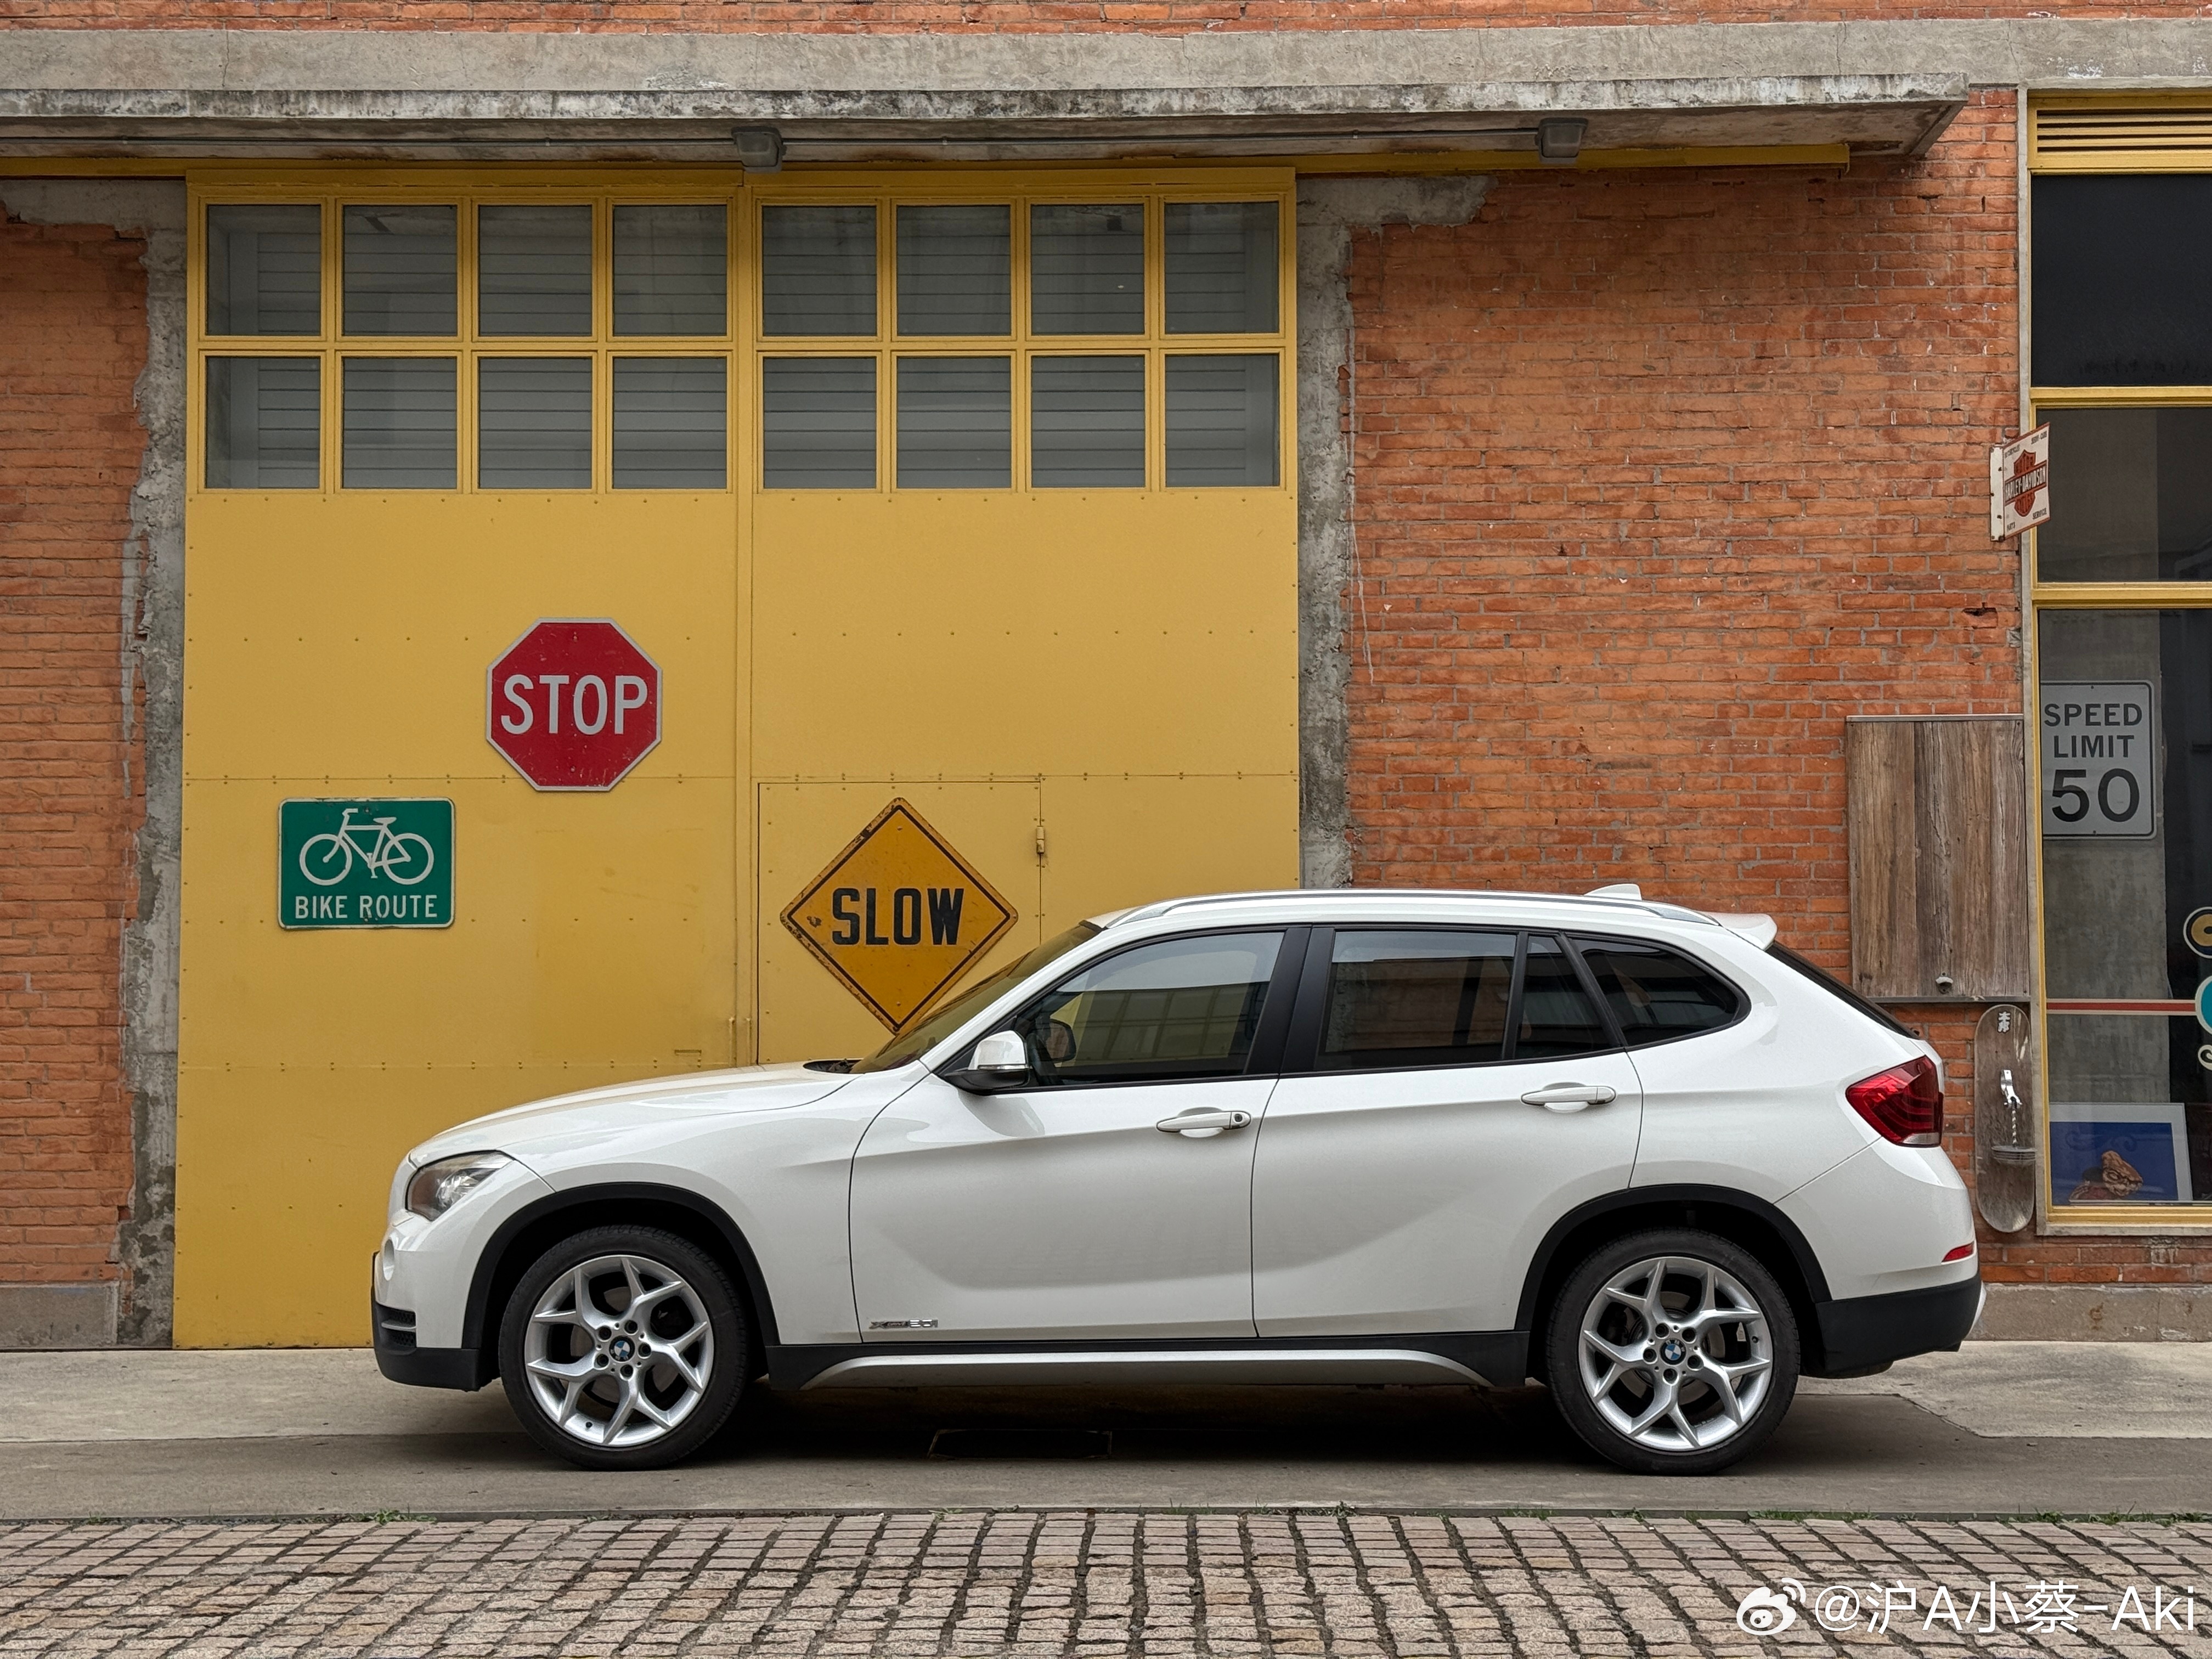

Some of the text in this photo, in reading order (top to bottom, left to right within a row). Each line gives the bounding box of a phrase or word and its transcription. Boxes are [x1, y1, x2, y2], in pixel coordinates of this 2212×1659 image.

[501, 674, 648, 735] STOP
[2044, 703, 2142, 726] SPEED
[2053, 735, 2134, 758] LIMIT
[2052, 768, 2140, 822] 50
[295, 895, 437, 919] BIKE ROUTE
[832, 888, 964, 945] SLOW
